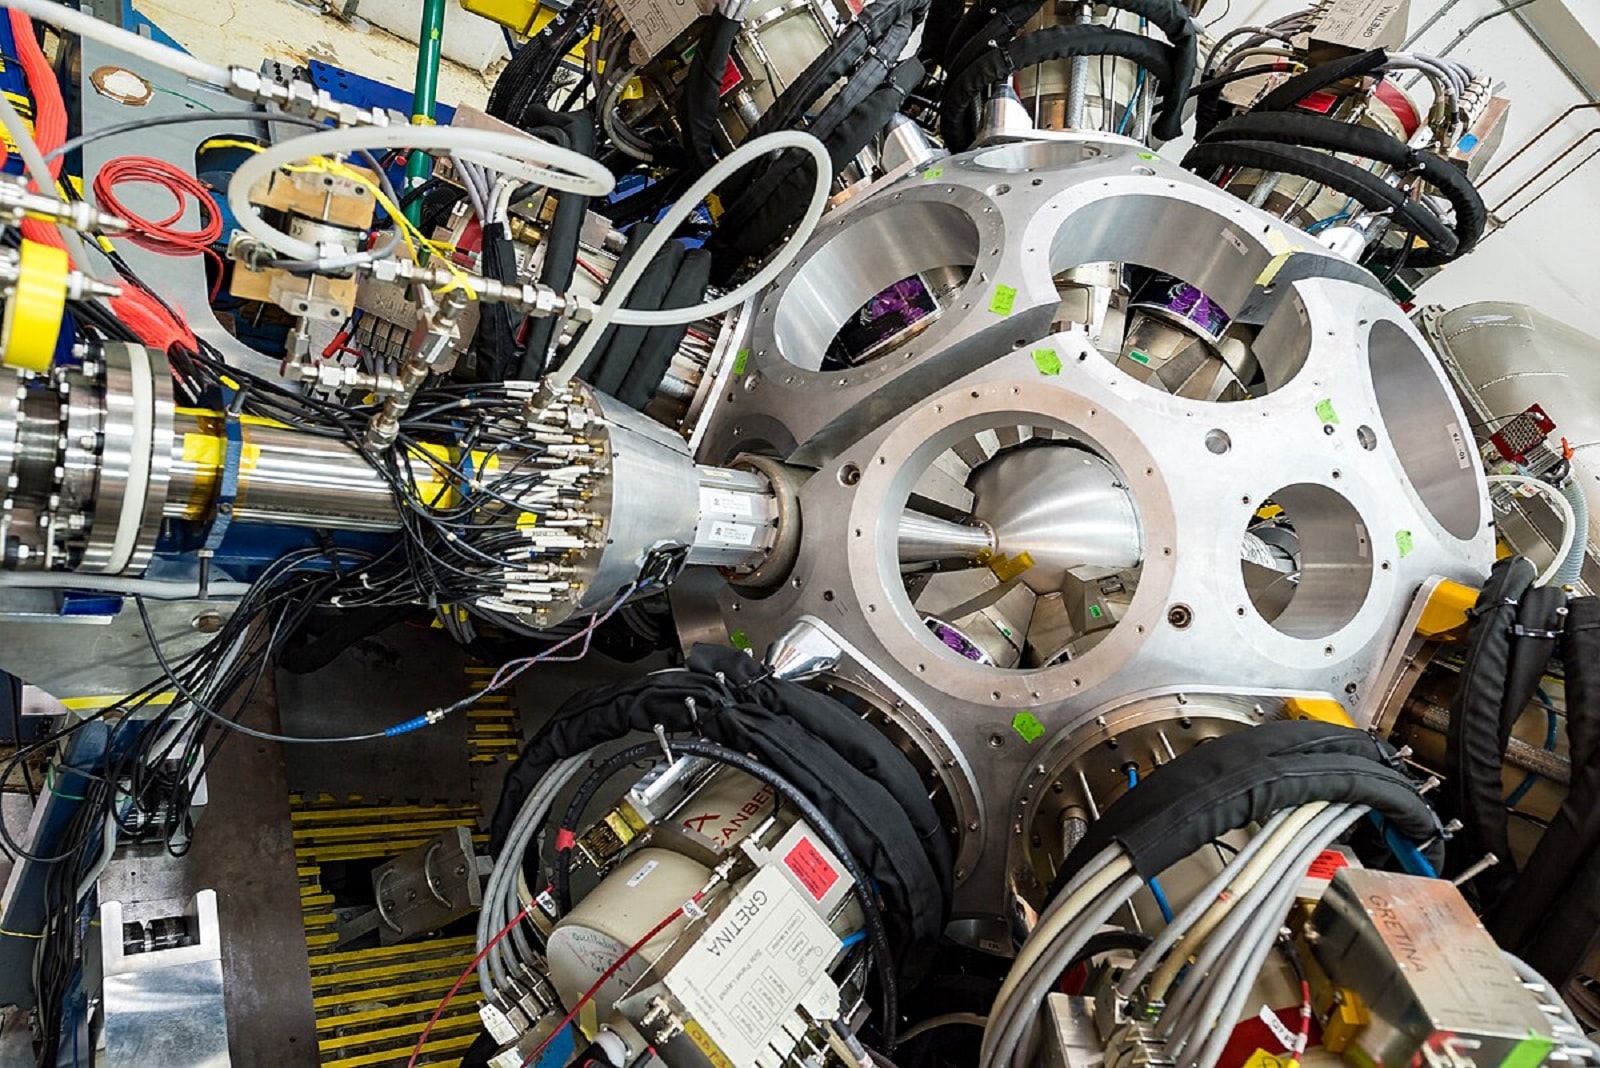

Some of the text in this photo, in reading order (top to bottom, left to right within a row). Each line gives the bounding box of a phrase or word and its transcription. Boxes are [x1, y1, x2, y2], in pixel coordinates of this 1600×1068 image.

[1363, 5, 1393, 38] GRETINA
[707, 890, 768, 956] GRETINA
[1369, 894, 1427, 973] GRETINA
